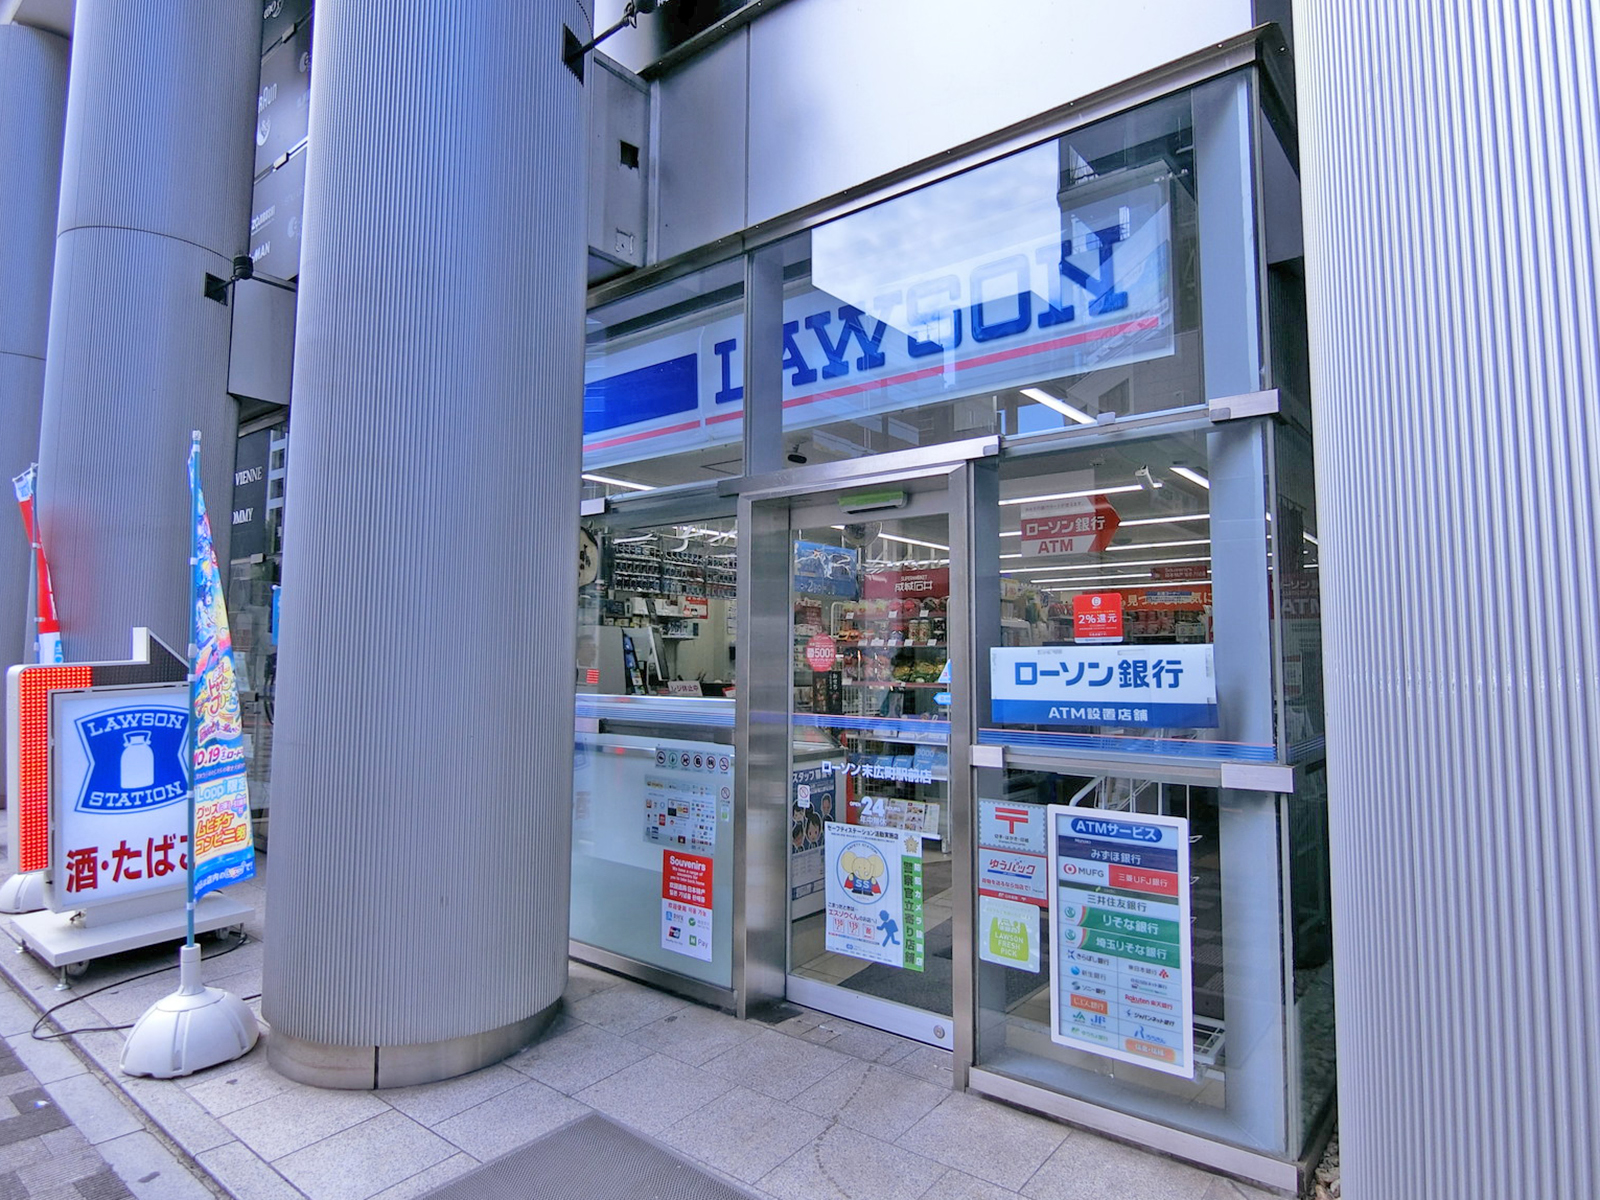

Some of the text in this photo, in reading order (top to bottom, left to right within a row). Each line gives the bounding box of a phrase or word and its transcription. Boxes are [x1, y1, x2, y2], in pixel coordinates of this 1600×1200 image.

[235, 466, 263, 487] VIENNE
[1026, 515, 1106, 536] ローソン銀行
[1038, 539, 1073, 555] ATM
[1014, 659, 1184, 689] ローソン銀行
[1048, 706, 1149, 722] ATM設置店舗
[87, 712, 185, 737] LAWSON
[88, 780, 183, 808] STATION
[861, 795, 885, 817] 24
[1076, 821, 1157, 842] ATMサービス
[670, 855, 706, 872] Souvenirs
[1090, 849, 1142, 865] みずほ銀行
[989, 858, 1036, 875] ゆうパック
[1078, 867, 1104, 878] MUFG
[856, 880, 870, 889] SS
[1118, 873, 1168, 888] 三菱UFJ銀行
[1087, 894, 1147, 912] 三井住友銀行
[1103, 914, 1159, 935] りそな銀行
[995, 931, 1024, 944] LAWSON
[997, 940, 1020, 950] FRESH
[1000, 948, 1017, 958] PICK
[1096, 936, 1167, 960] 埼玉りそな銀行
